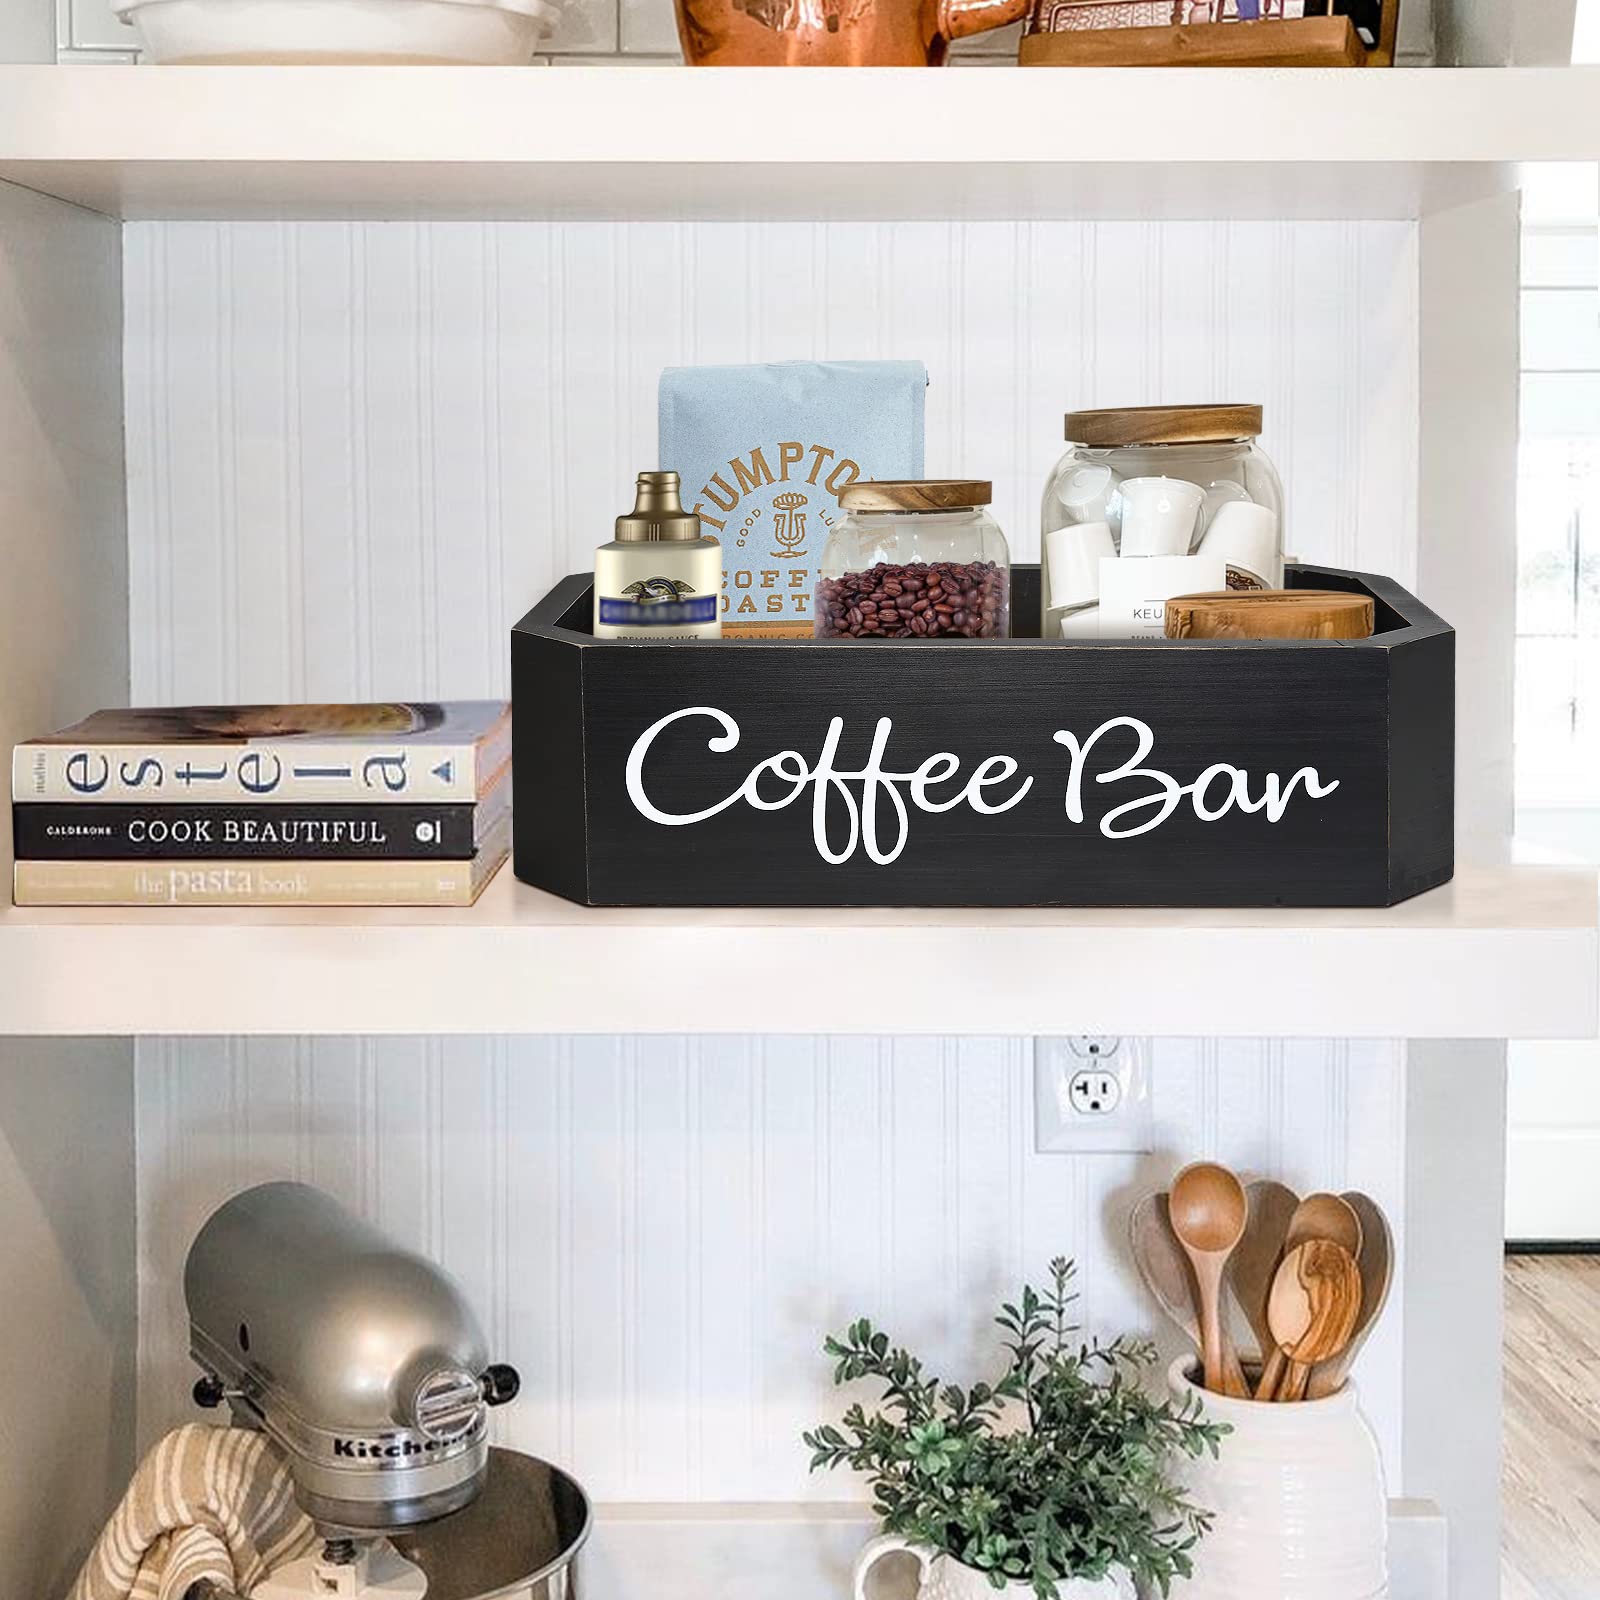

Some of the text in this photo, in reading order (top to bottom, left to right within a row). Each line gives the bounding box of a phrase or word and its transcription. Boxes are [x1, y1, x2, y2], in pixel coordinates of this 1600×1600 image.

[693, 442, 873, 544] TUMPTO
[736, 508, 762, 547] GOOD
[721, 569, 821, 589] OFF
[65, 751, 407, 794] estela
[625, 706, 1340, 865] Coffee Bar
[128, 820, 387, 843] COOK BEAUTIFUL
[169, 867, 252, 902] pasta
